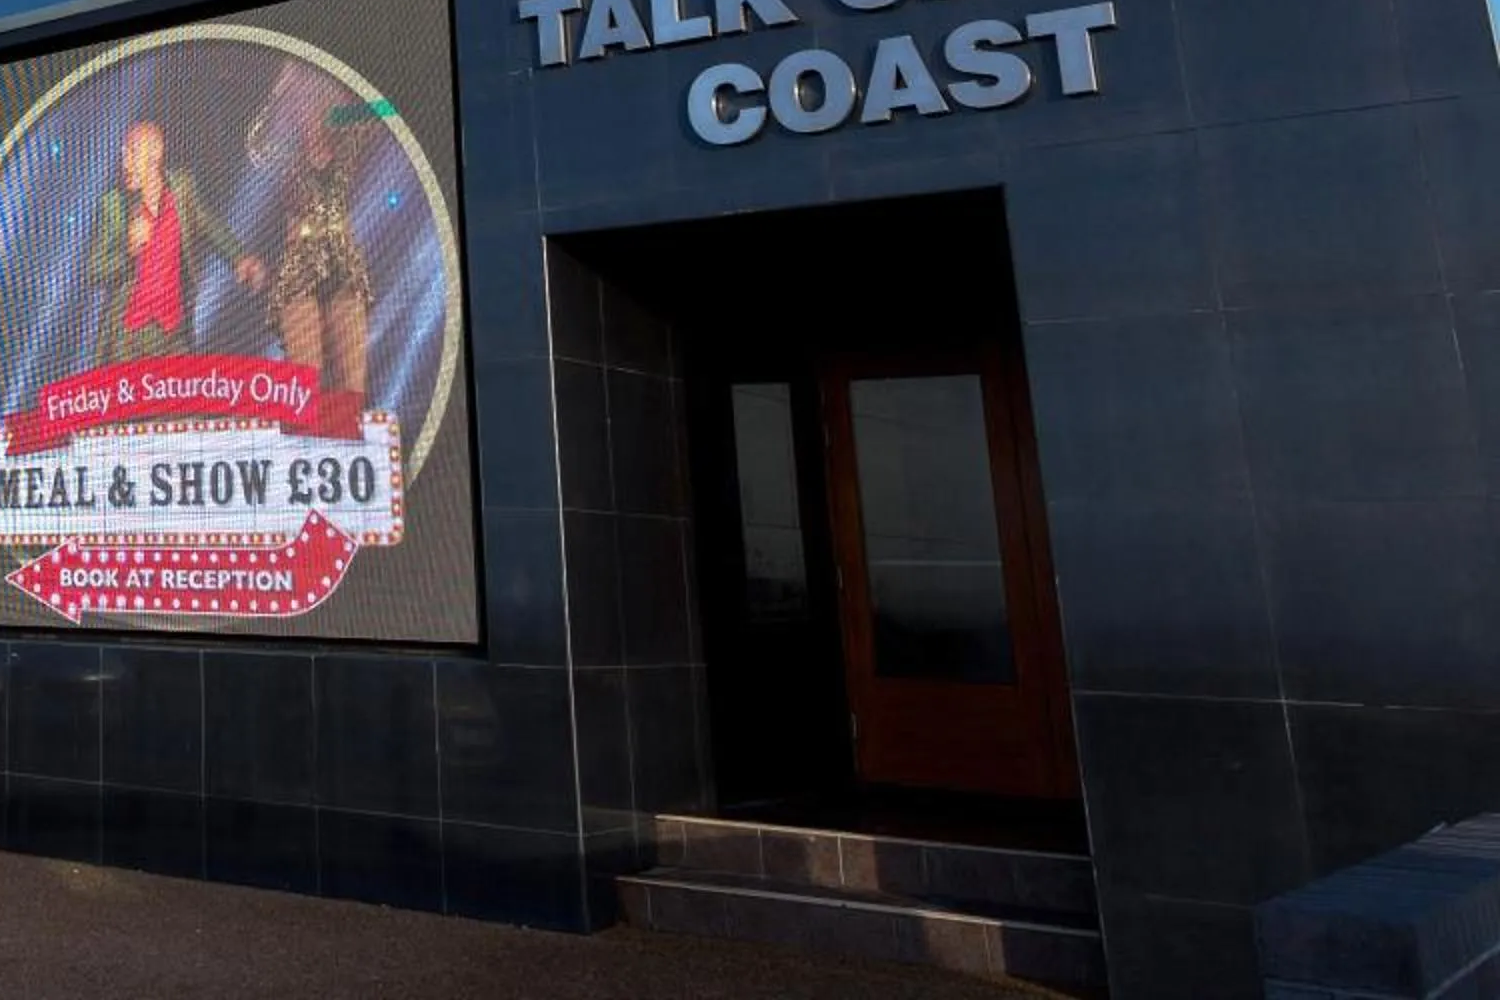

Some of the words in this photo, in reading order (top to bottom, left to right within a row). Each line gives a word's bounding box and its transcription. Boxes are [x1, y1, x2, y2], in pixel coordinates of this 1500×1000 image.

[687, 0, 1119, 146] COAST
[46, 384, 112, 421] Friday
[117, 375, 136, 403] &
[141, 371, 243, 406] Saturday
[250, 373, 312, 415] Only
[107, 463, 137, 503] &
[148, 459, 275, 508] SHOW
[286, 455, 378, 503] £30
[59, 567, 120, 589] BOOK
[126, 568, 153, 590] AT
[161, 568, 293, 592] RECEPTION
